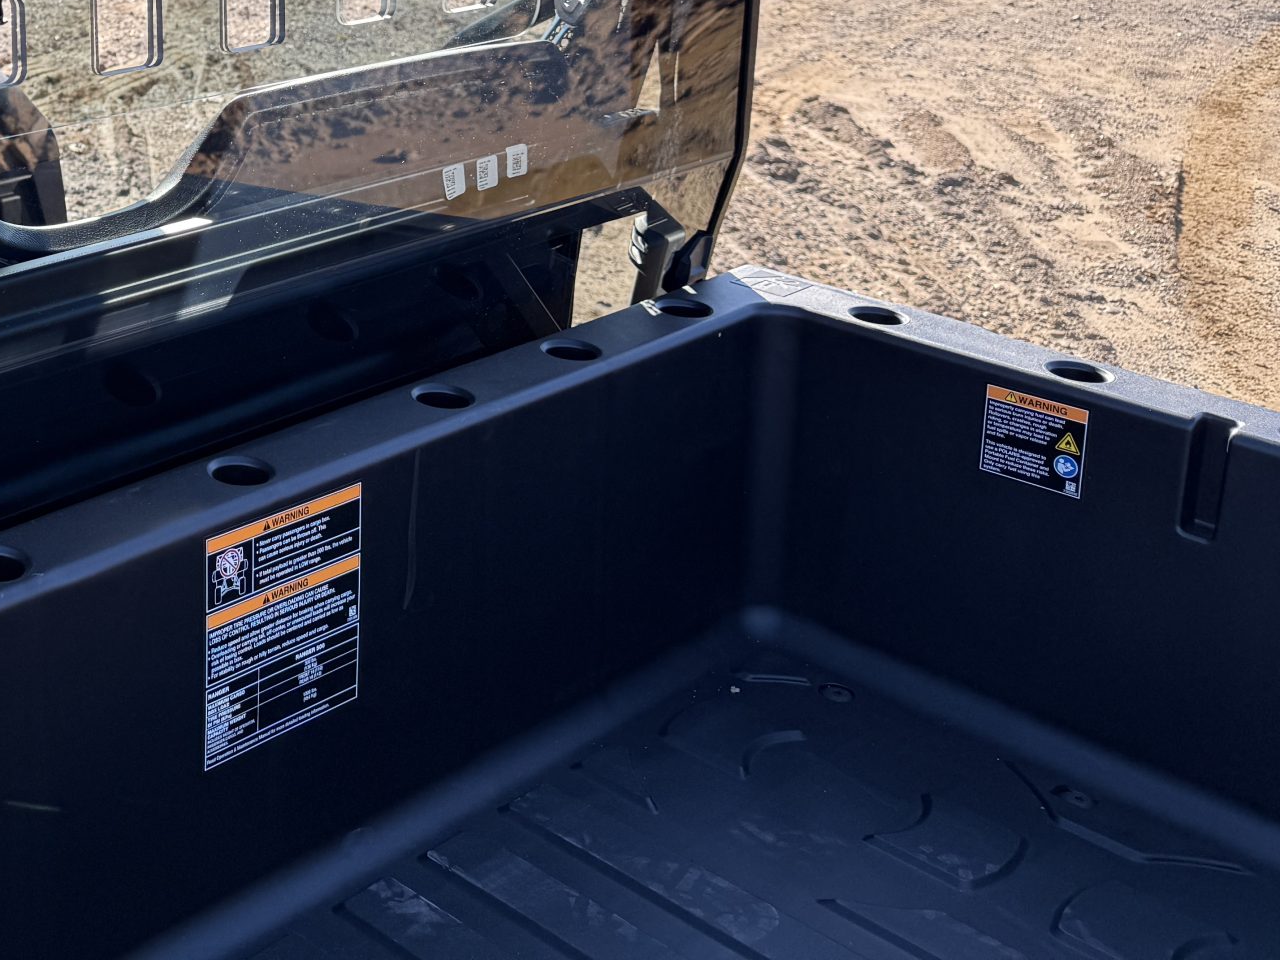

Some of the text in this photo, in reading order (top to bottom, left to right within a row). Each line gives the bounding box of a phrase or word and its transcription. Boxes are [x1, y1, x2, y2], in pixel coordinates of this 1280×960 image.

[1018, 395, 1068, 415] WARNING
[271, 506, 309, 527] WARNING
[271, 577, 308, 600] WARNING
[295, 646, 315, 660] RANGER
[208, 685, 229, 700] RANGER
